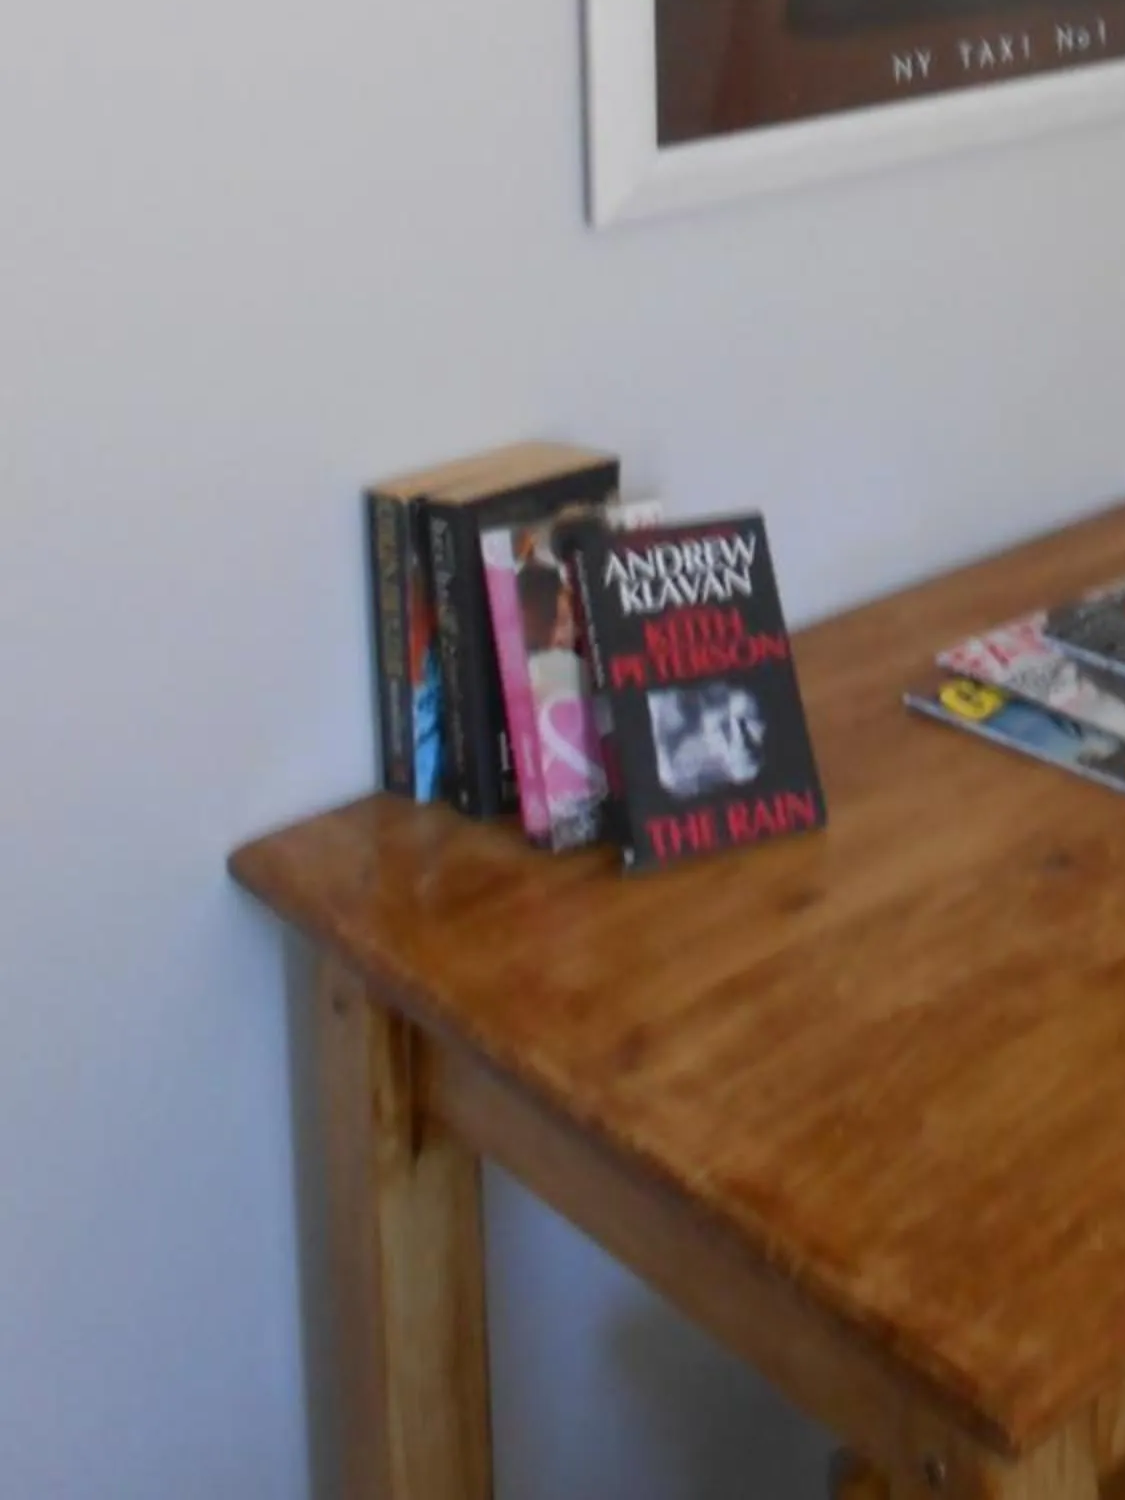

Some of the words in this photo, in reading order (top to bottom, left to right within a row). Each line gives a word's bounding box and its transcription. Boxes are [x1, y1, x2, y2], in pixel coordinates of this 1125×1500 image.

[892, 48, 932, 85] NY
[959, 33, 1030, 70] TAXI
[604, 531, 757, 589] ANDREW
[619, 566, 753, 617] KLAVAN
[644, 807, 717, 866] THE
[727, 789, 816, 846] RAIN
